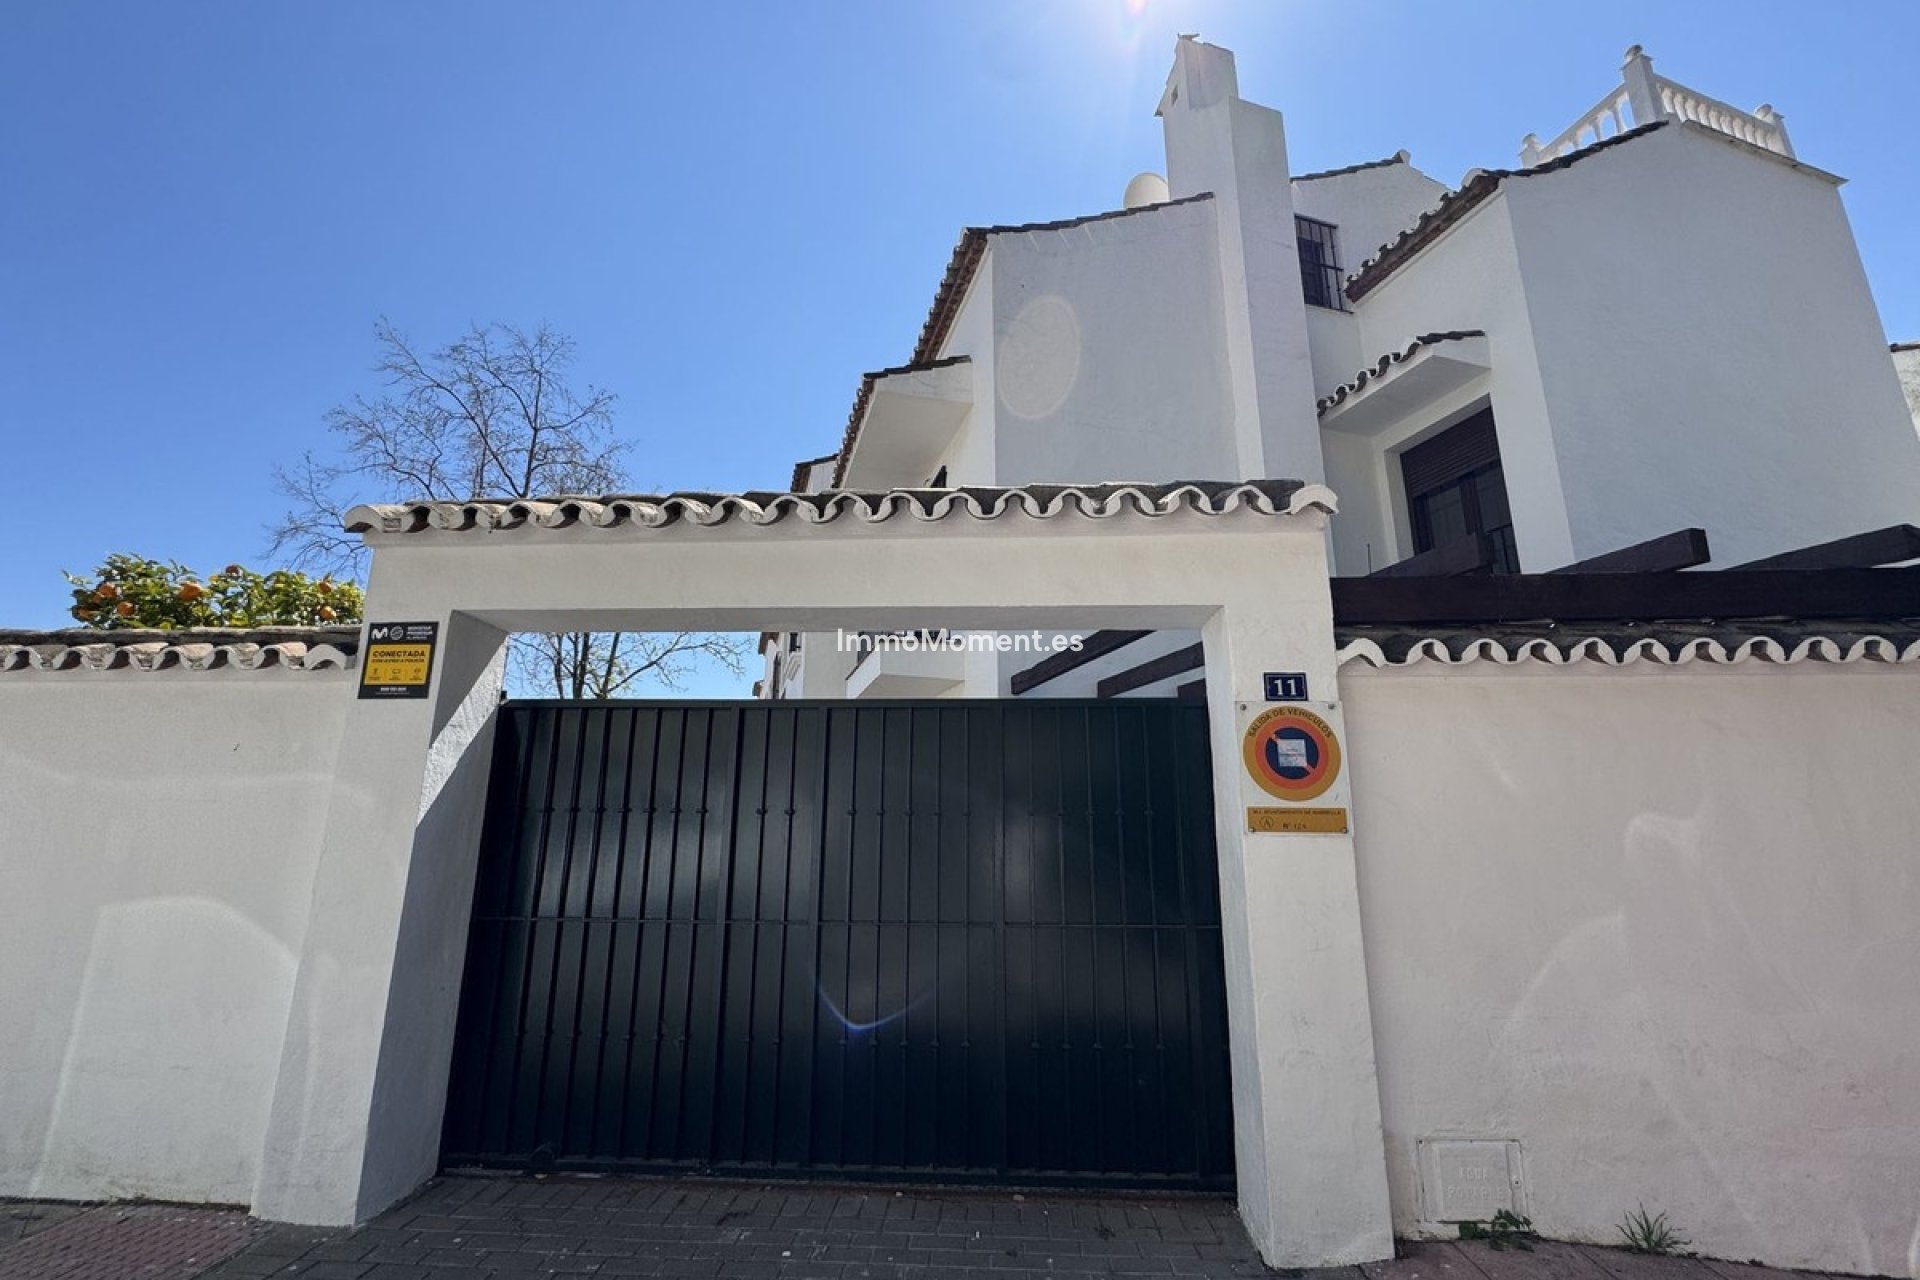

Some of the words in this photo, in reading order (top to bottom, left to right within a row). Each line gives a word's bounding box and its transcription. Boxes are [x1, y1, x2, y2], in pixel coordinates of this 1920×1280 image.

[1273, 679, 1297, 696] 11
[1248, 714, 1273, 737] SALIDA
[1273, 708, 1285, 716] DE
